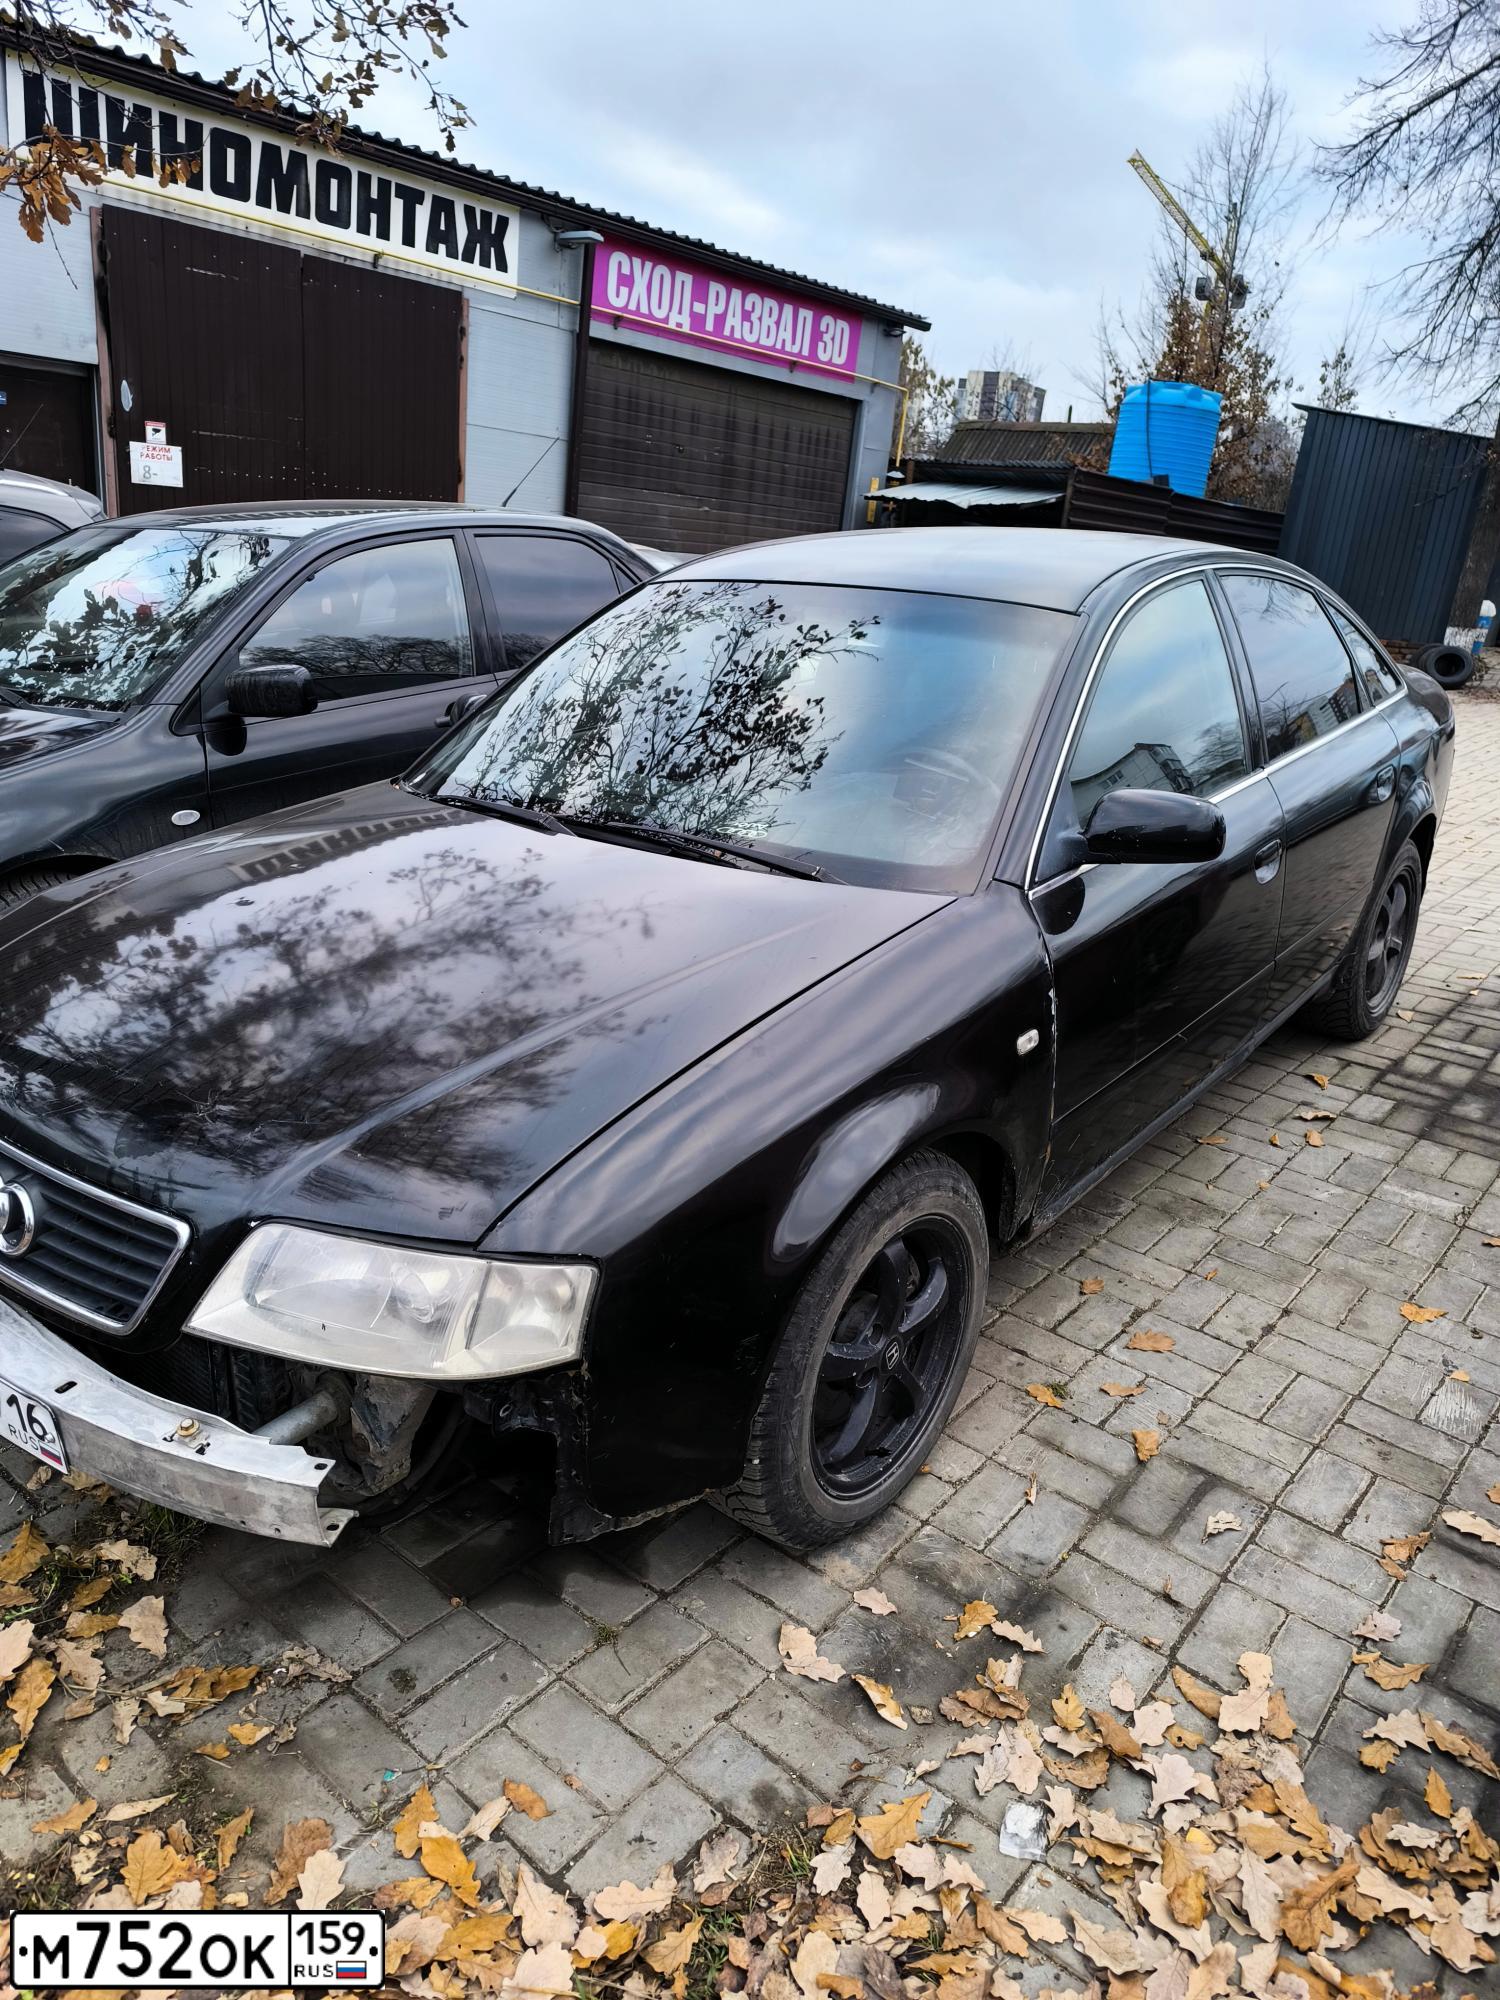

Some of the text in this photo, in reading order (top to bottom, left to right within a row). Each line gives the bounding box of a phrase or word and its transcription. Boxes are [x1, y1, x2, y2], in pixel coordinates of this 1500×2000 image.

[23, 69, 510, 274] ШИНОМОНТАЖ
[606, 251, 850, 366] СХОД-РАЗВАЛ 3D
[6, 1393, 49, 1442] 16
[7, 1423, 39, 1451] RUS
